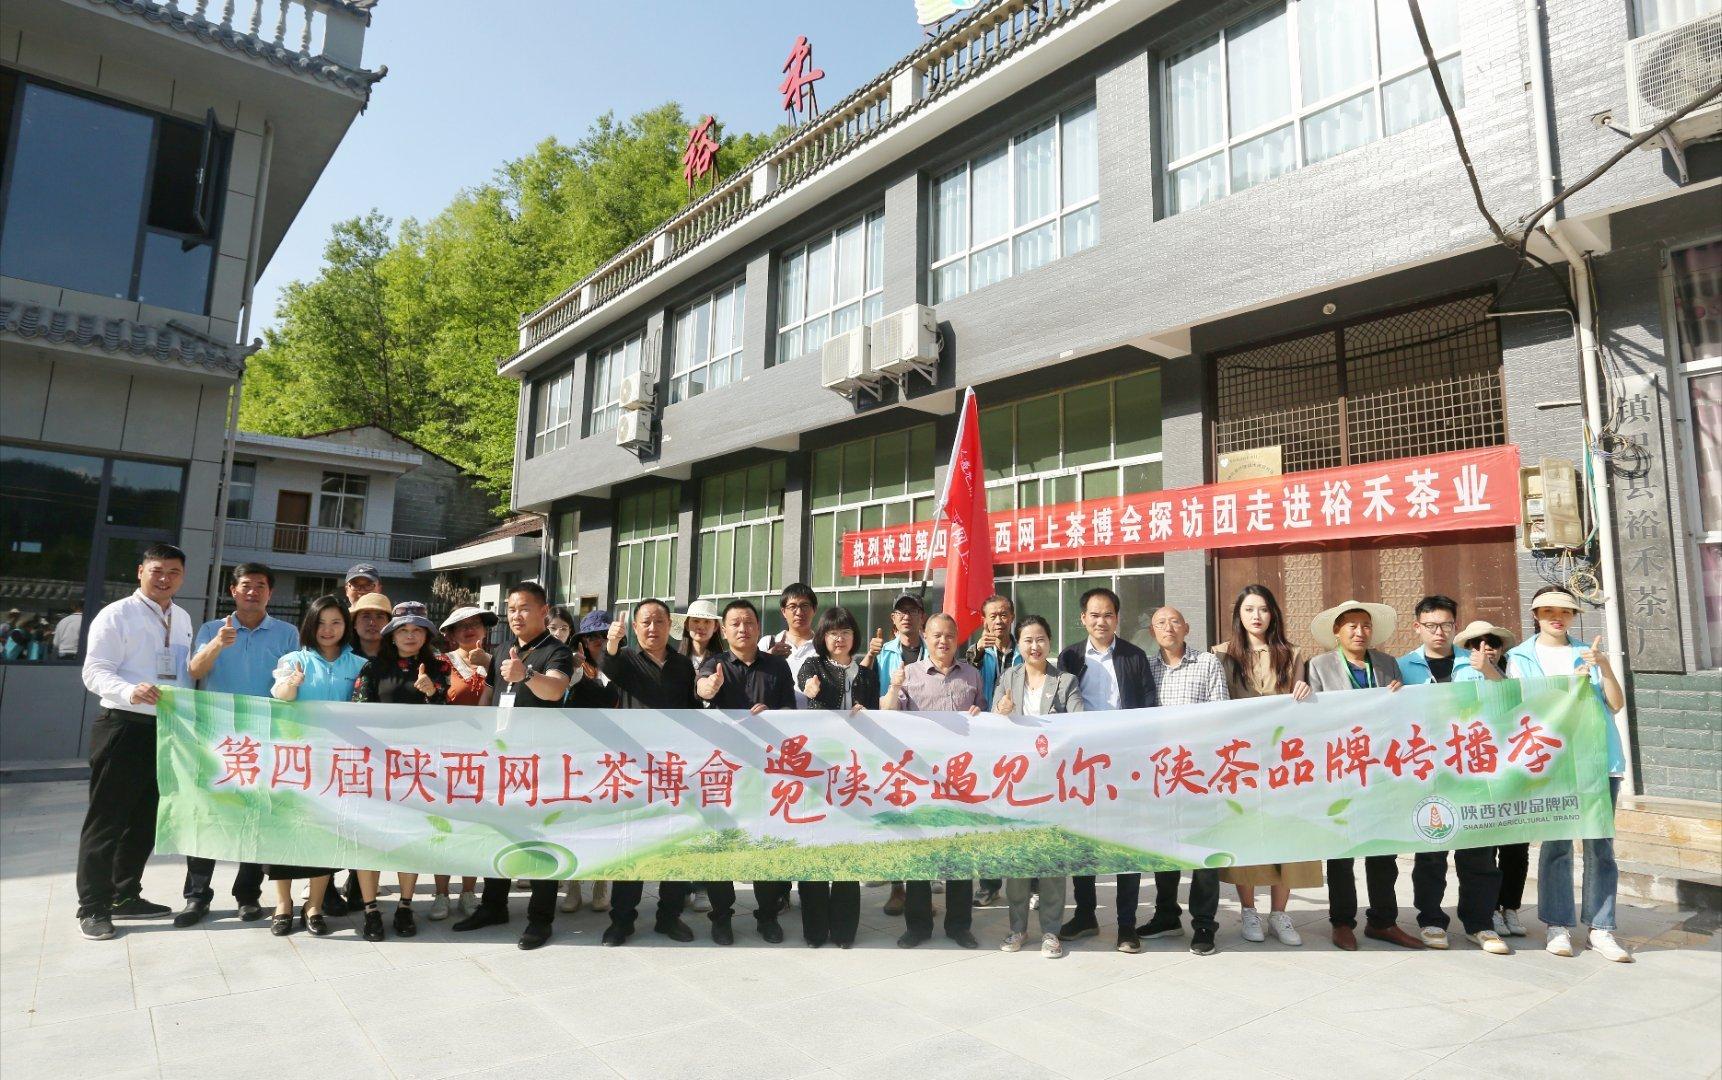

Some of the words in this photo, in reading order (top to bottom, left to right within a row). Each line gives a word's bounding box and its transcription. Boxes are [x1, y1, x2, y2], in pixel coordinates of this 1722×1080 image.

[852, 464, 1491, 568] 热烈欢迎第四西网上茶博会探访团走进裕禾茶业
[1460, 795, 1578, 821] 陕西农业品牌网
[1463, 823, 1496, 831] SHAANXI
[1498, 816, 1550, 827] AGRICULTURAL
